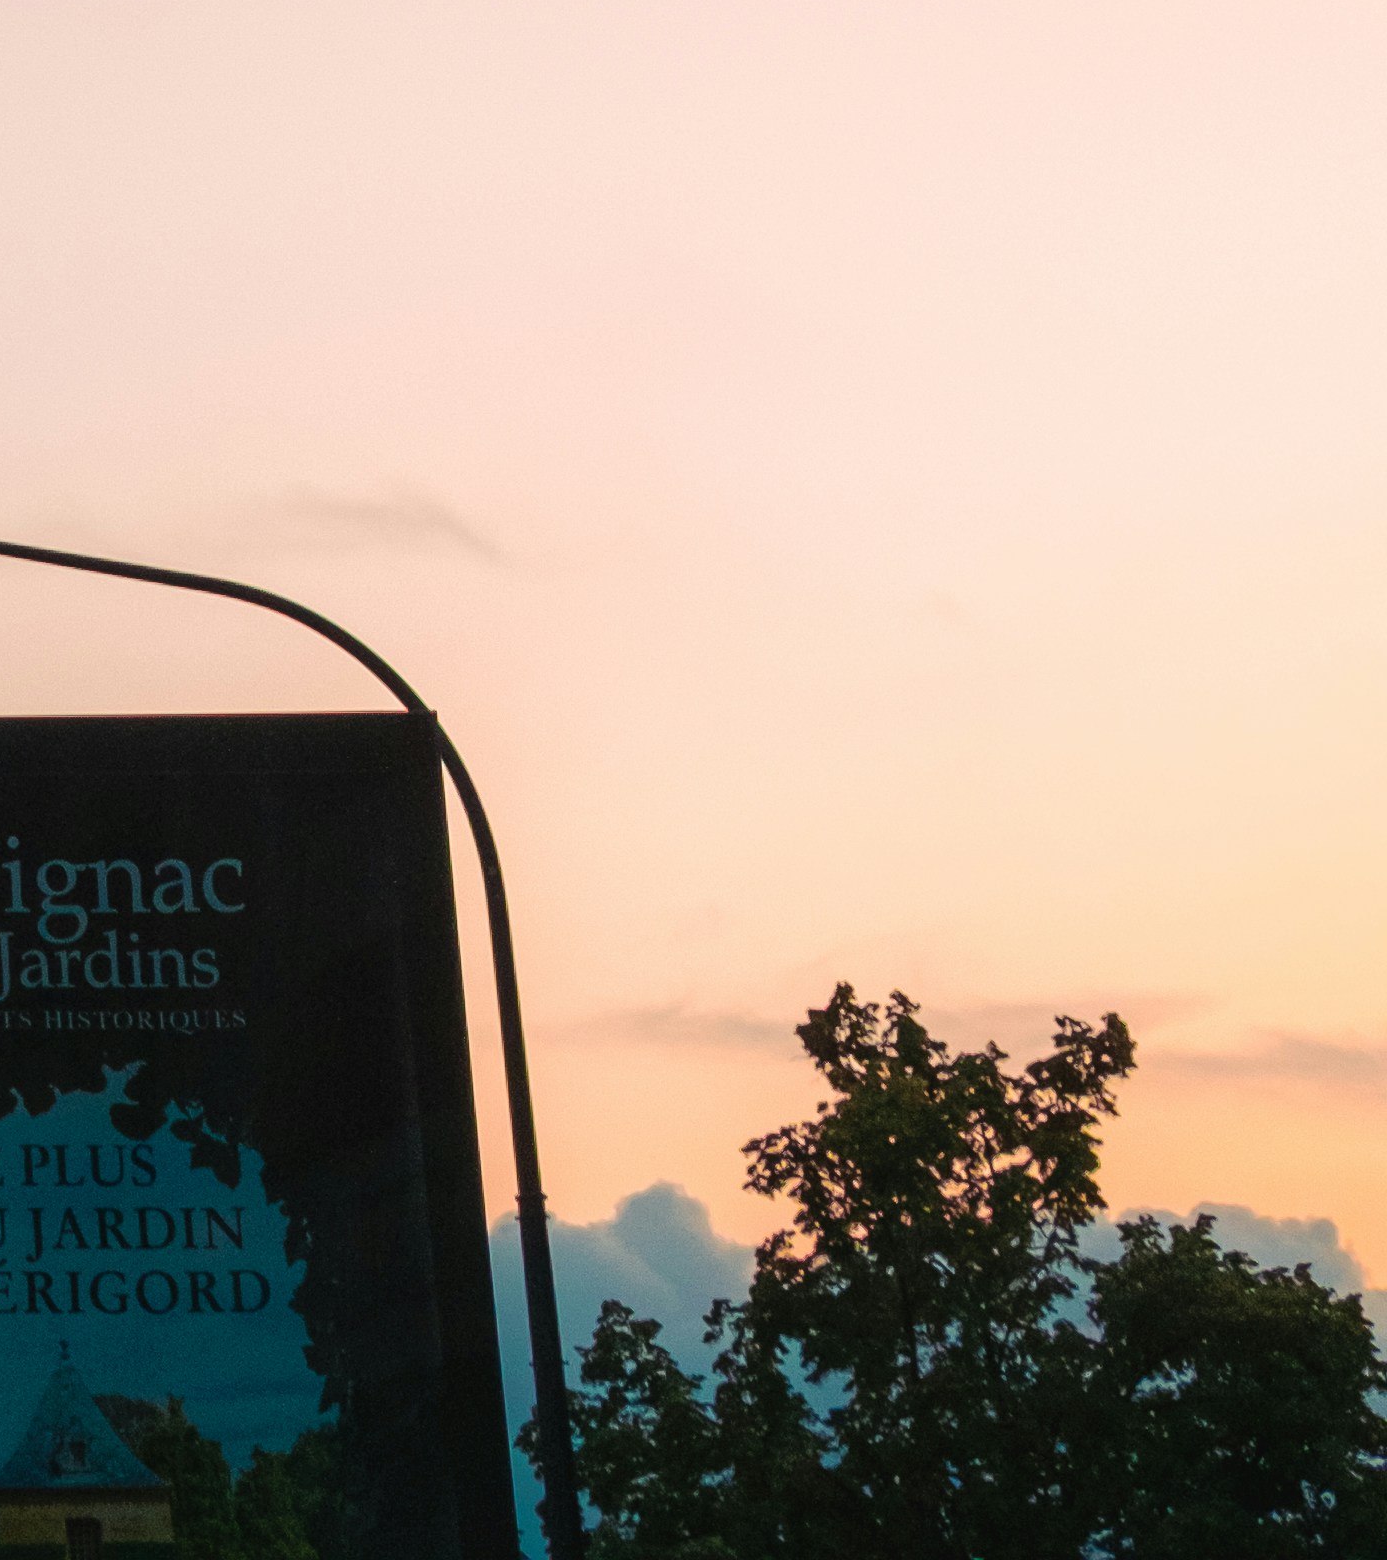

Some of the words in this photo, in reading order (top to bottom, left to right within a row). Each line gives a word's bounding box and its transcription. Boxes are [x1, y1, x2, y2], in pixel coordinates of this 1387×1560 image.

[43, 1009, 249, 1036] HISTORIQUES
[20, 1143, 158, 1188] PLUS
[26, 1206, 245, 1262] JARDIN
